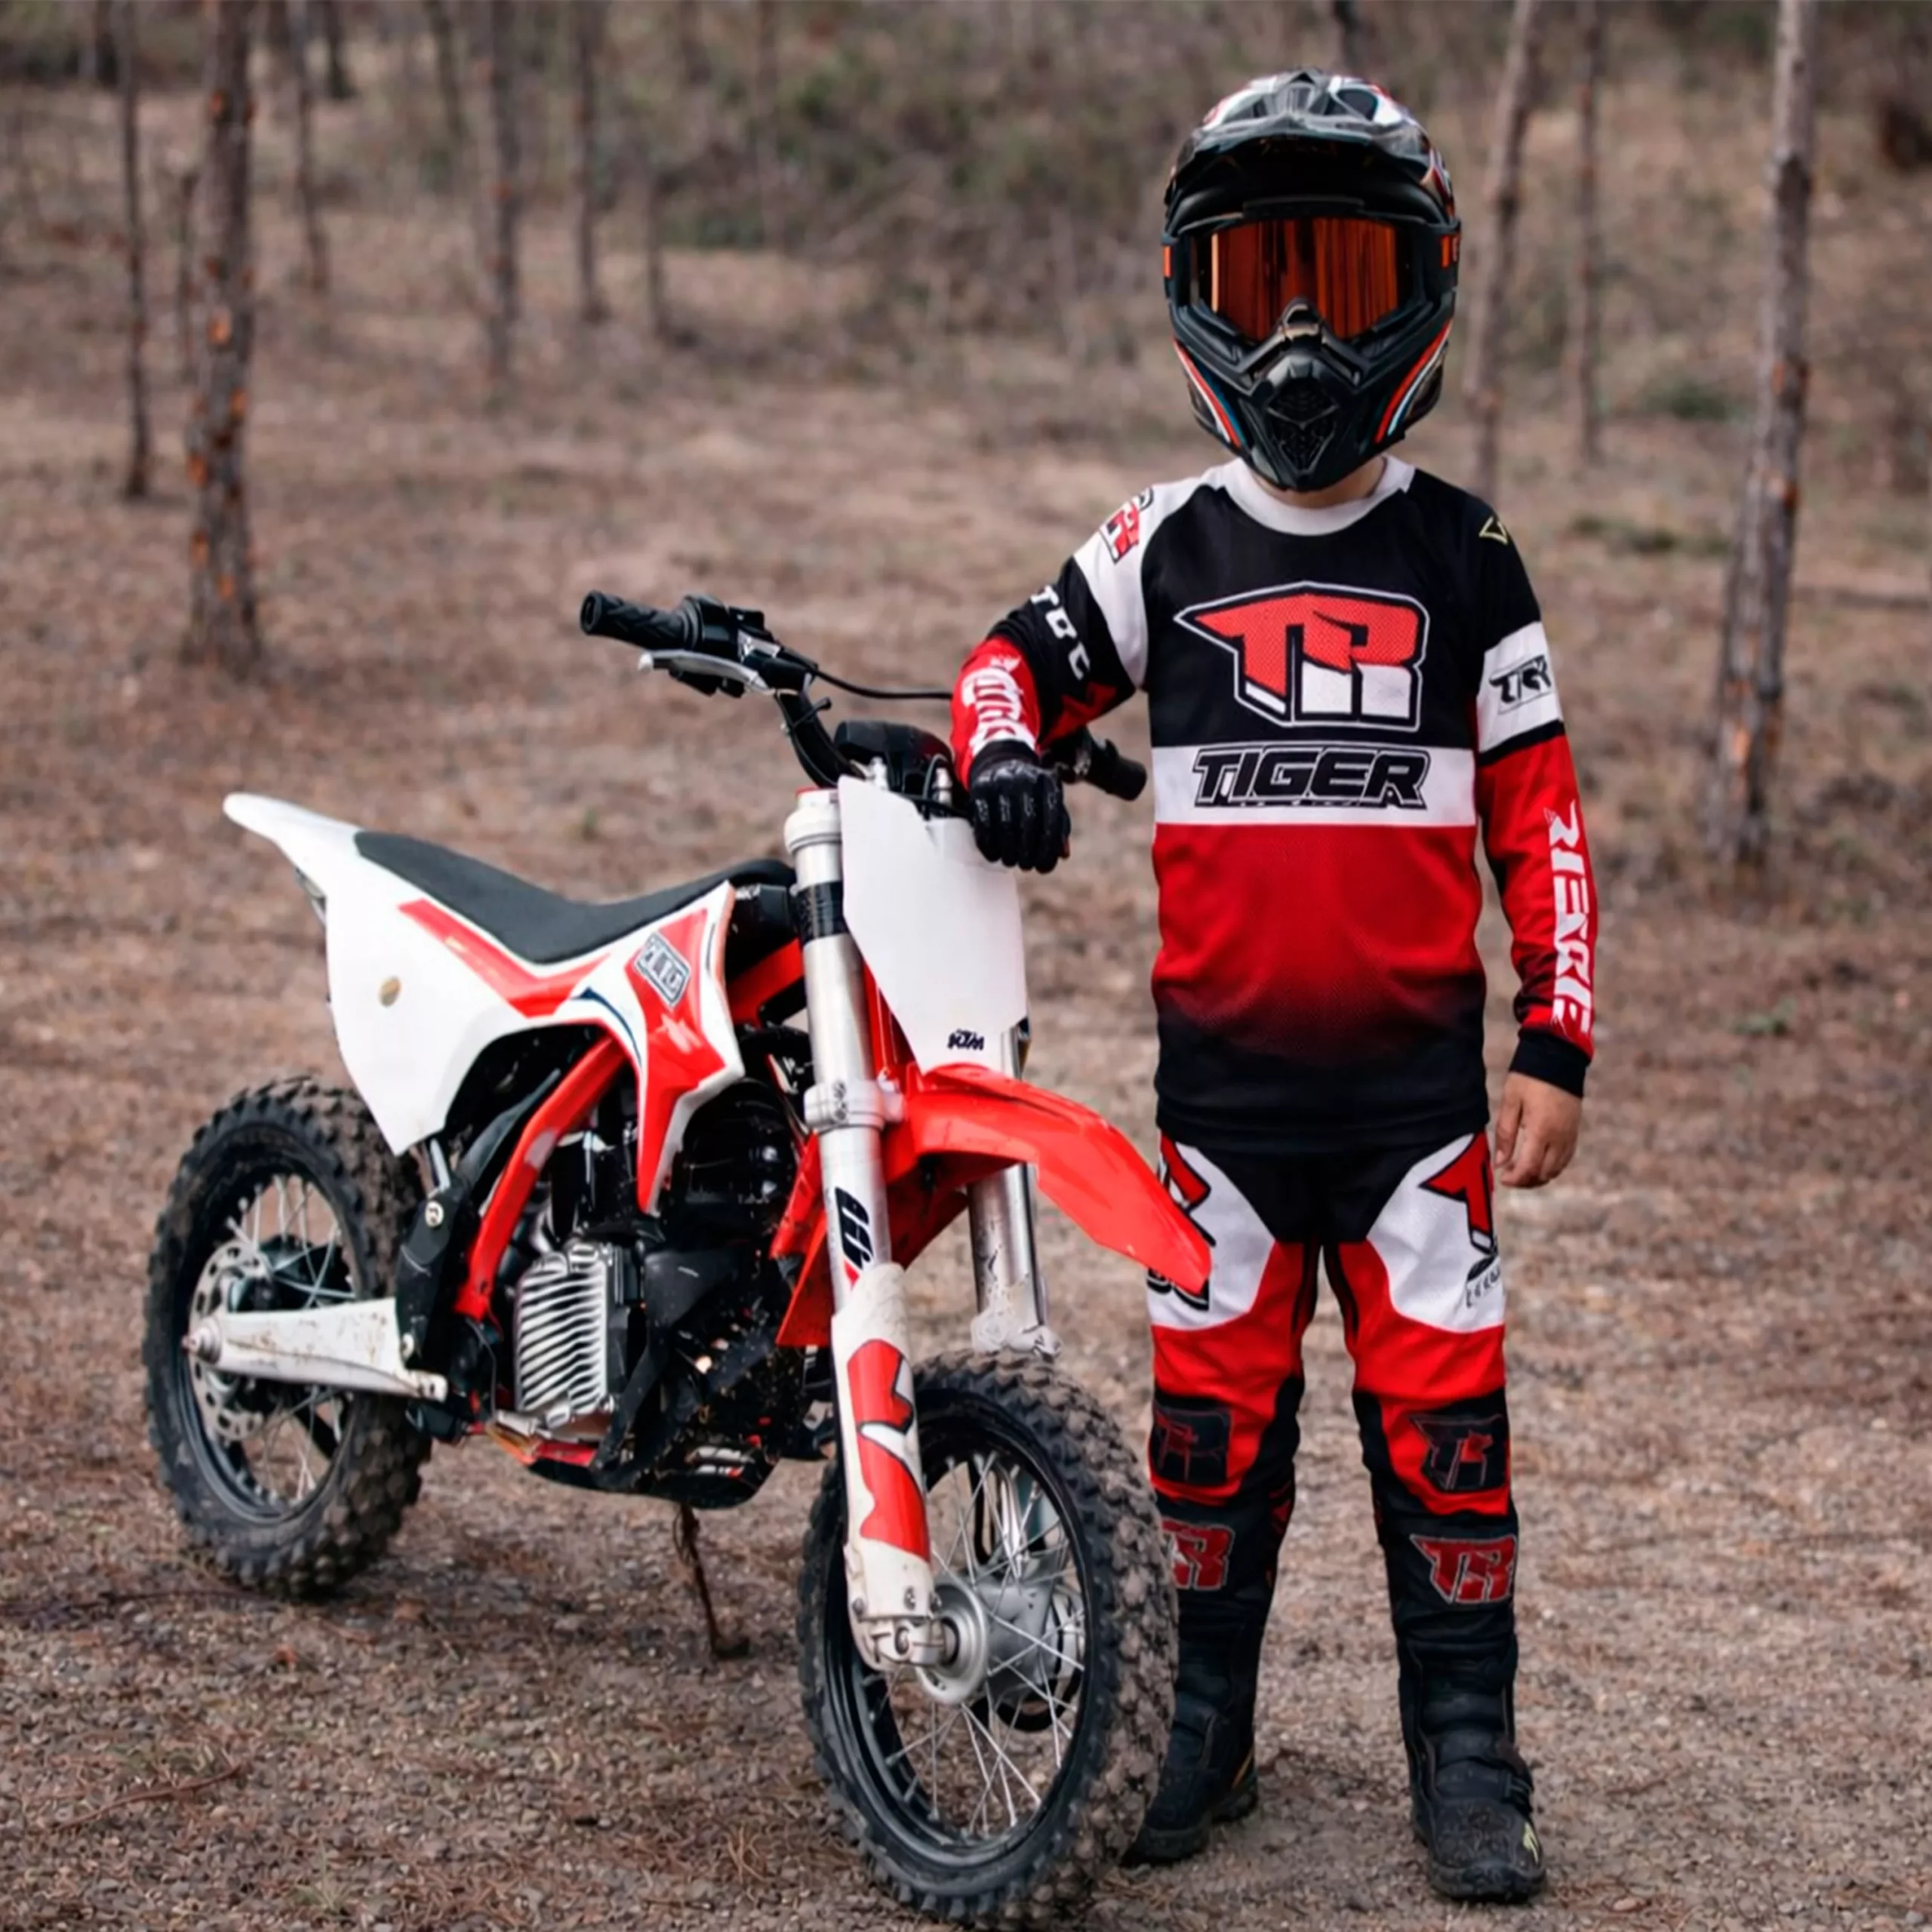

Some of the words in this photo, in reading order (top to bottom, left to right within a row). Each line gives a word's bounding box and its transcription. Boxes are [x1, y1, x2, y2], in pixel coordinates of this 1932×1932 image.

[1182, 587, 1424, 726] TR
[1192, 744, 1431, 810] TIGER
[947, 1028, 984, 1051] KTM
